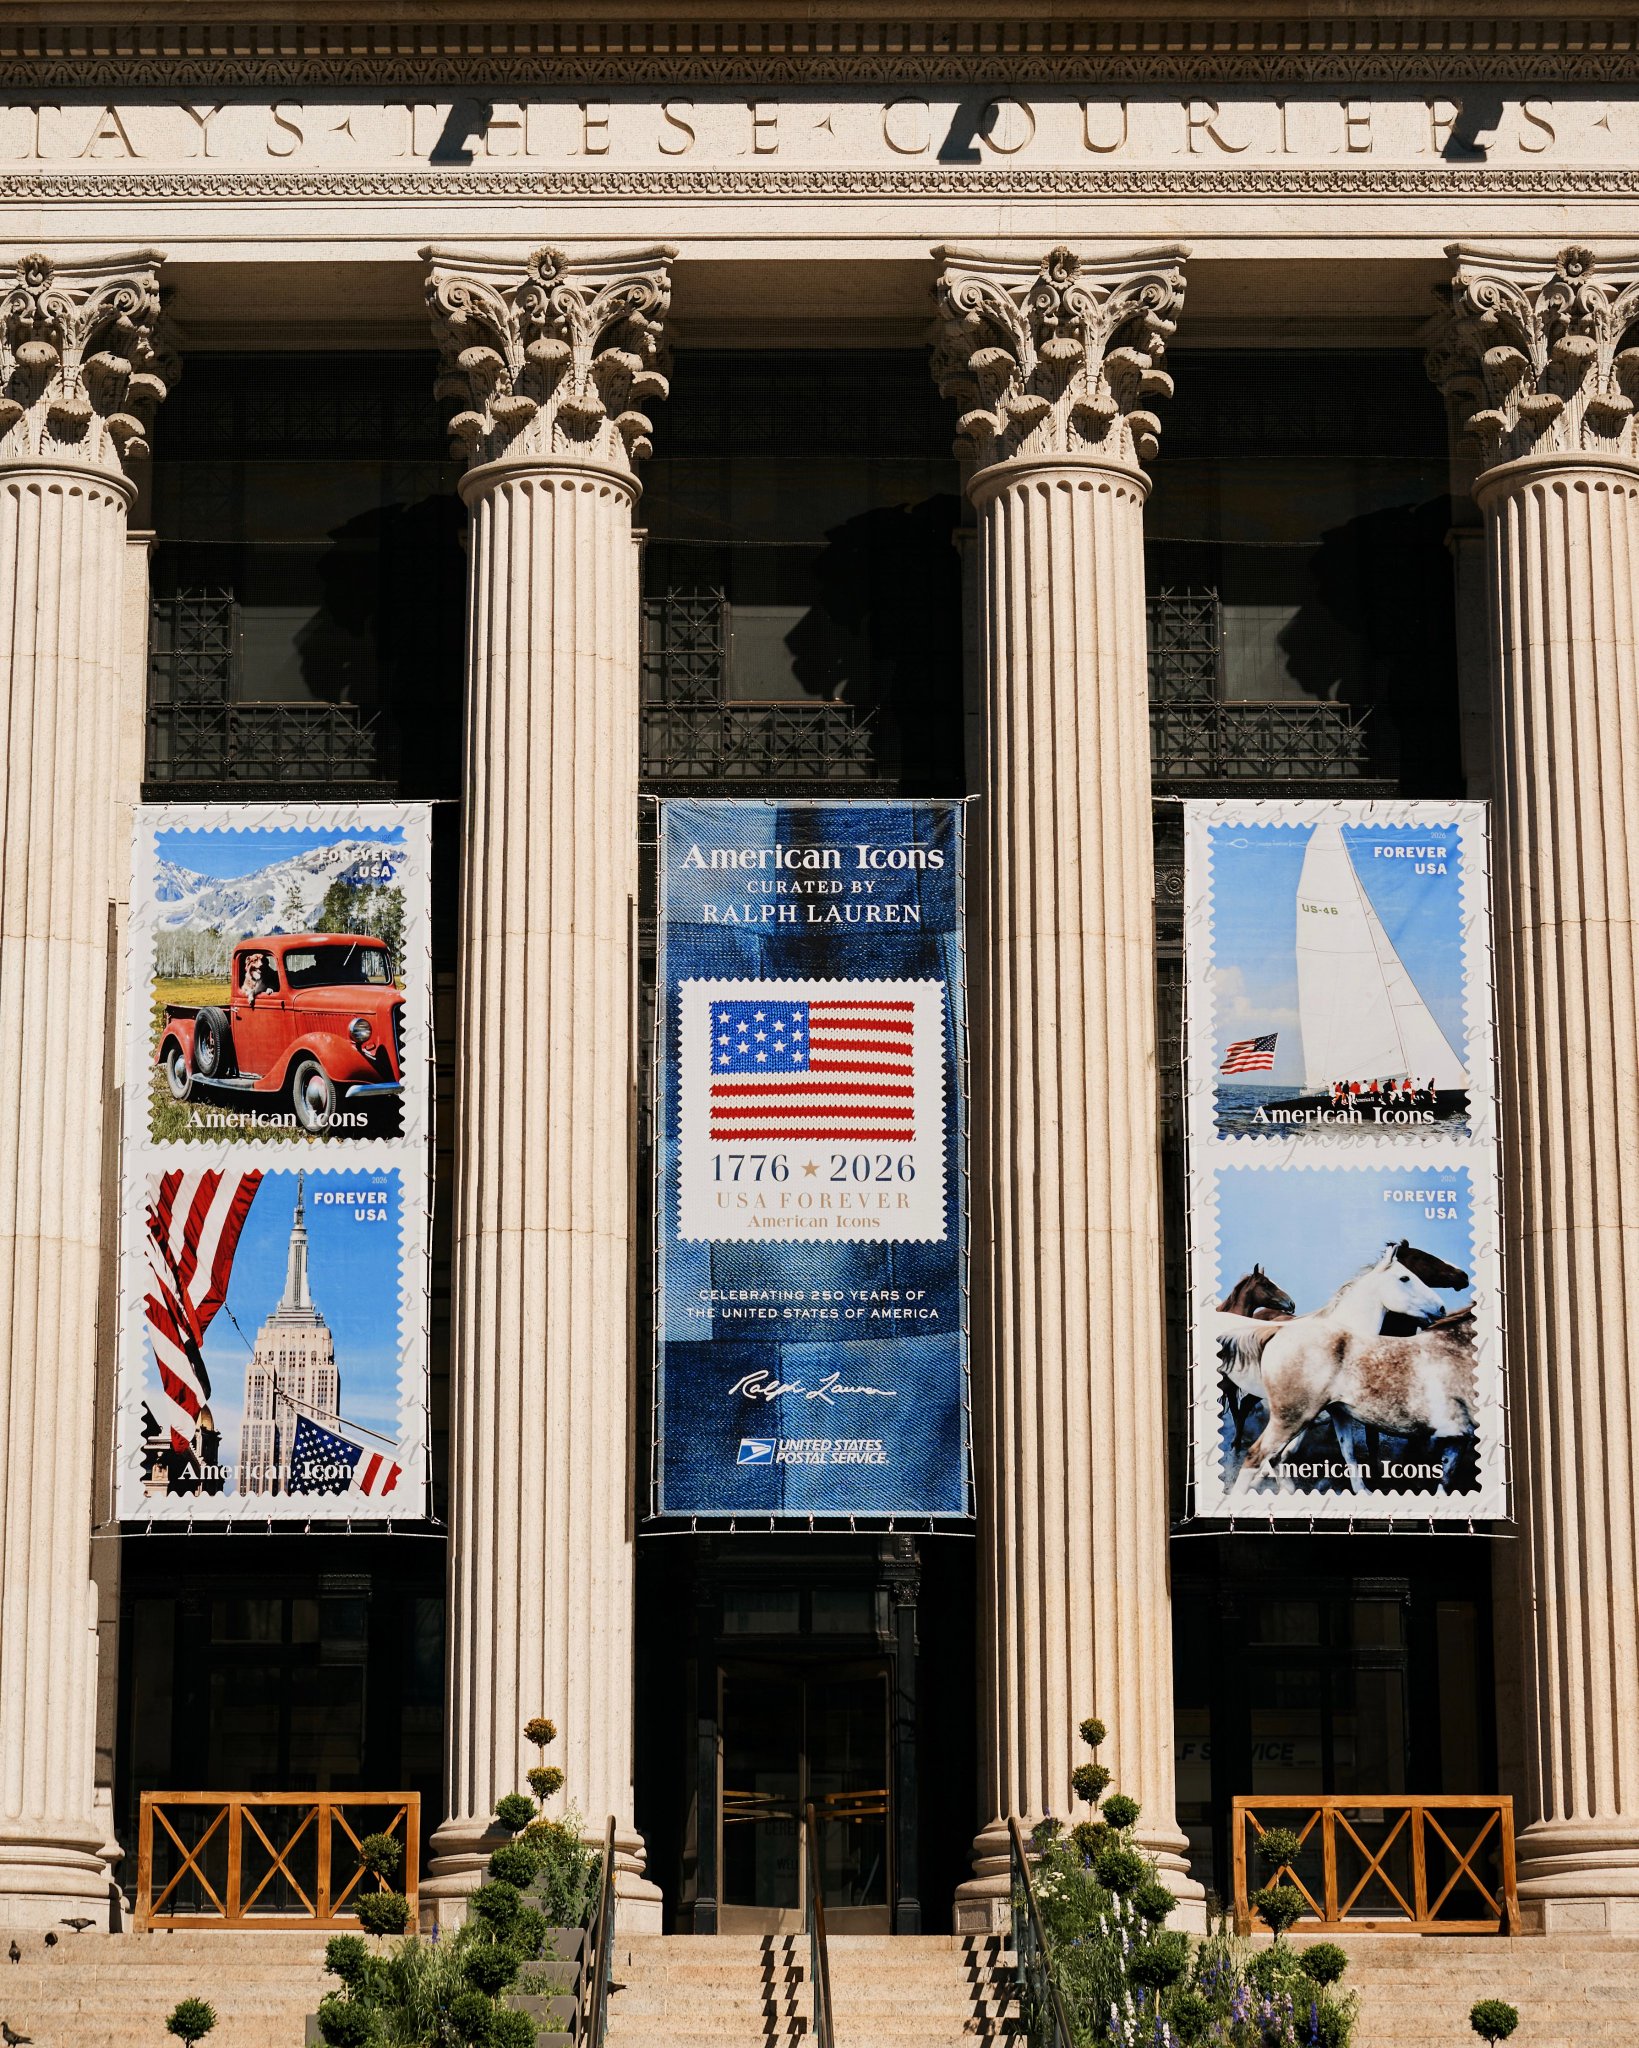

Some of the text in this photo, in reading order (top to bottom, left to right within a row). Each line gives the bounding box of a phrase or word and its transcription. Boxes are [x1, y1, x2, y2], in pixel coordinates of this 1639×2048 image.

[383, 97, 780, 157] THESE
[880, 95, 1556, 155] COURIERS
[319, 849, 391, 861] FOREVER
[680, 844, 945, 870] American Icons
[1374, 846, 1447, 858] FOREVER
[360, 865, 391, 878] USA
[1414, 863, 1447, 875] USA
[748, 881, 876, 894] CURATED BY
[703, 905, 922, 923] RALPH LAUREN
[1301, 903, 1338, 916] US-46
[184, 1109, 368, 1128] American Icons
[1250, 1106, 1435, 1125] American Icons
[710, 1154, 916, 1182] 1776 2026
[371, 1176, 388, 1184] 2026
[314, 1192, 388, 1204] FOREVER
[716, 1192, 911, 1209] USA FOREVER
[1383, 1190, 1457, 1202] FOREVER
[354, 1208, 388, 1221] USA
[1424, 1207, 1458, 1220] USA
[747, 1215, 881, 1228] American Icons
[699, 1290, 926, 1301] CELEBRATING 250 YEARS OF
[687, 1308, 939, 1319] THE UNITED STATES OF AMERICA
[779, 1439, 882, 1451] UNITED STATES
[776, 1452, 827, 1464] POSTAL
[178, 1461, 292, 1480] American
[1259, 1459, 1444, 1478] American Icons
